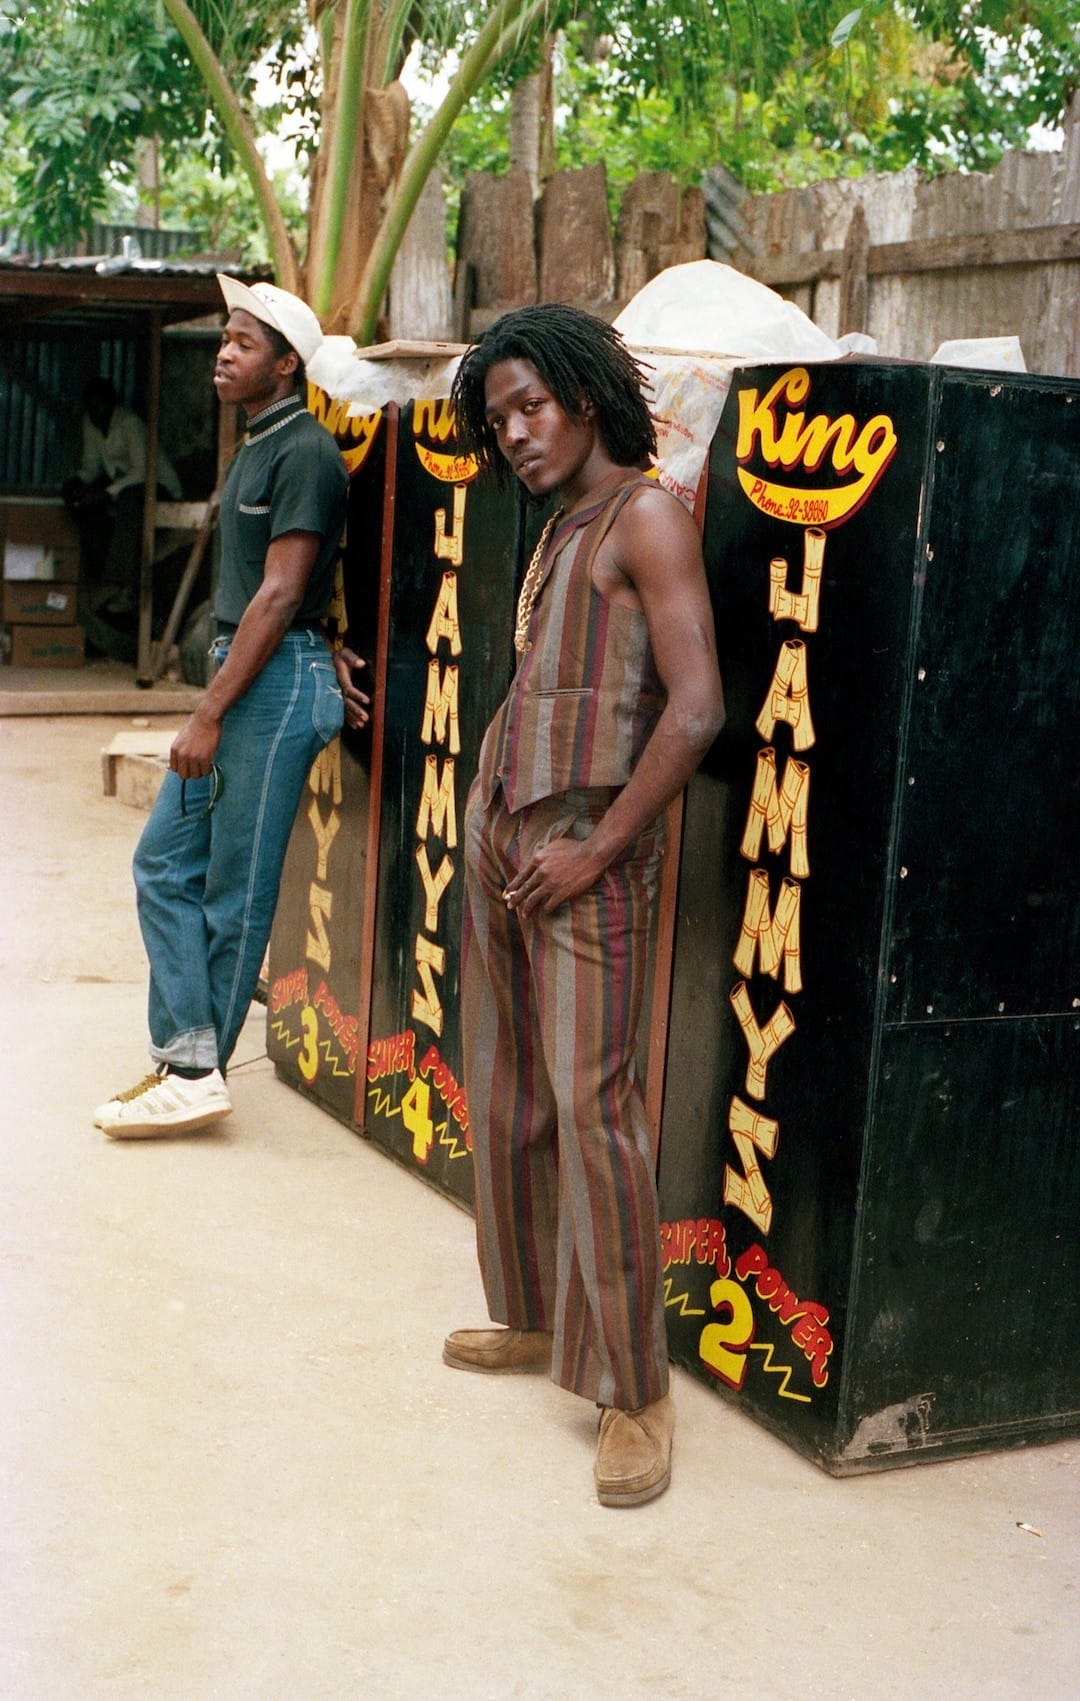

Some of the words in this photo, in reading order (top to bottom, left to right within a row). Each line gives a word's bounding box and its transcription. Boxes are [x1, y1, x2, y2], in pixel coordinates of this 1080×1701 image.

[736, 368, 897, 525] King
[271, 966, 309, 1014] SUPER
[313, 980, 359, 1075] POWER
[298, 1005, 321, 1086] 3
[367, 1028, 416, 1083] SUPER
[401, 1076, 434, 1165] 4
[659, 1218, 732, 1279] SUPER
[735, 1243, 834, 1388] POWER
[699, 1278, 756, 1393] 2
